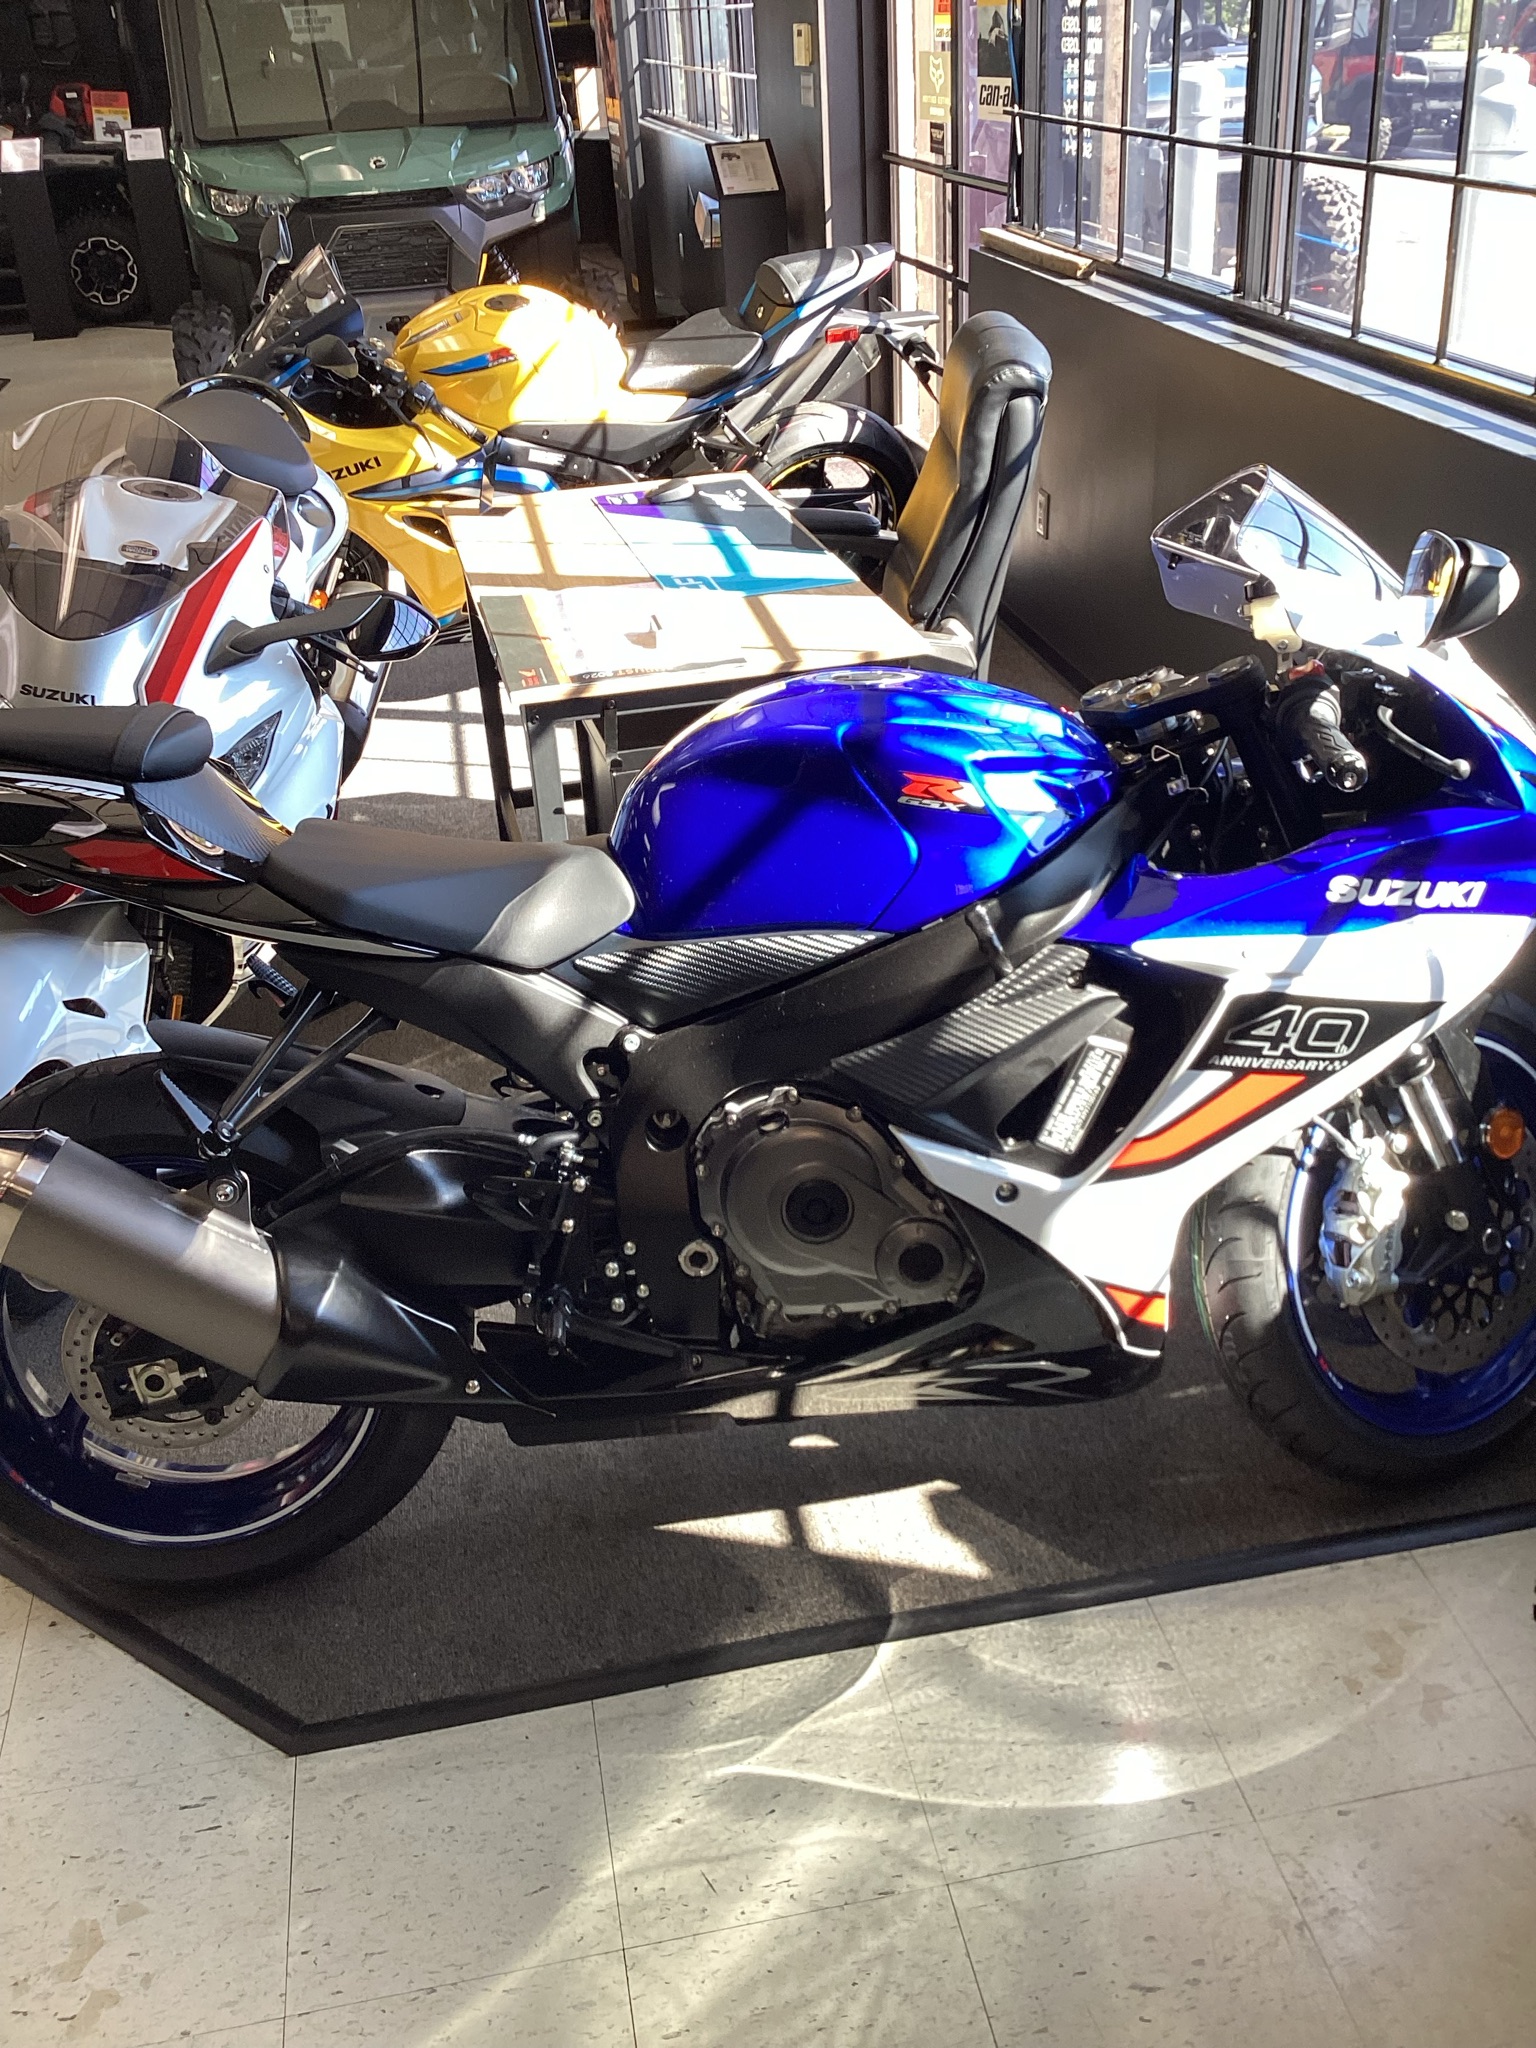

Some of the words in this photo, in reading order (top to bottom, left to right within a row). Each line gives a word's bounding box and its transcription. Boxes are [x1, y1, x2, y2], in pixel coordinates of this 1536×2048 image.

[20, 683, 96, 706] SUZUKI
[897, 795, 966, 812] GSX
[1325, 874, 1487, 909] SUZUKI
[1208, 1054, 1329, 1071] ANNIVERSARY
